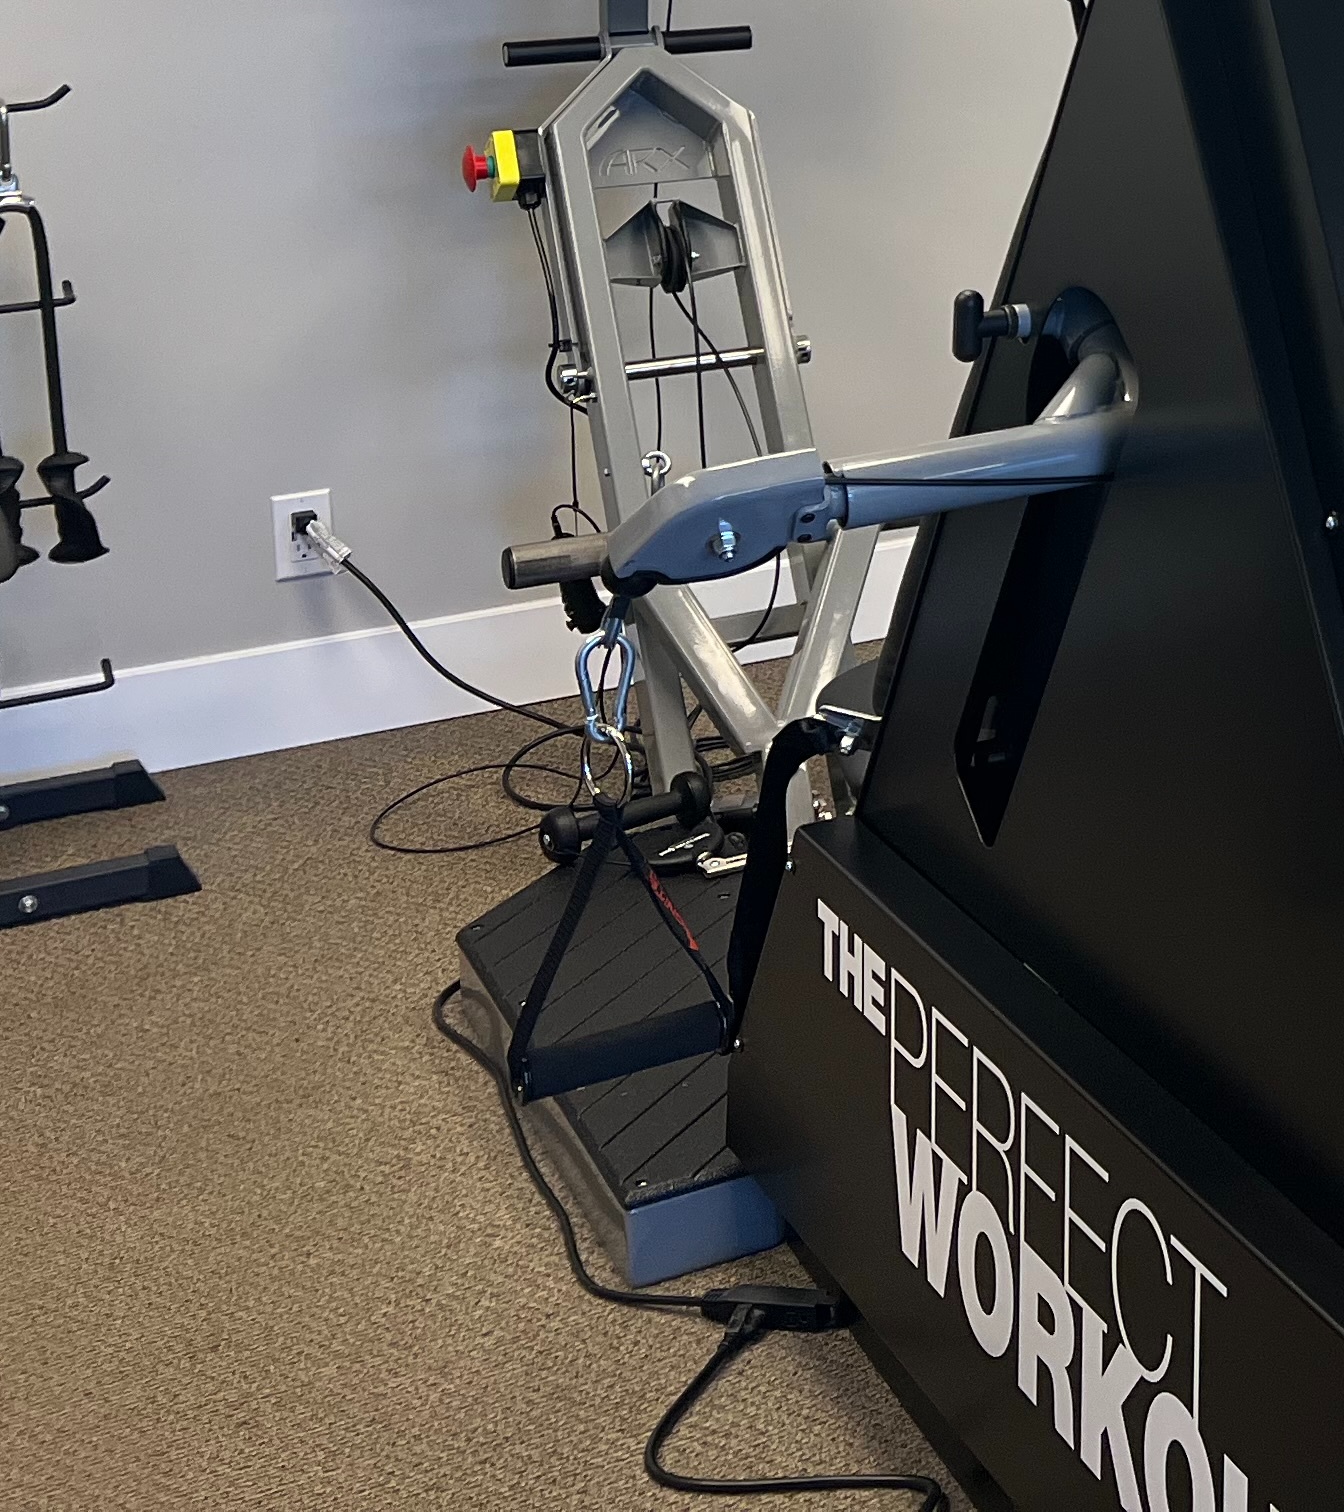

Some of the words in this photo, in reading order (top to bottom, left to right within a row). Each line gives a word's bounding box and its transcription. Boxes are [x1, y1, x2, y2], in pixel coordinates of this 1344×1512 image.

[598, 145, 690, 177] ARX
[816, 898, 887, 1037] THE
[889, 966, 1228, 1432] PERFECT
[889, 1102, 1282, 1512] WORKO
